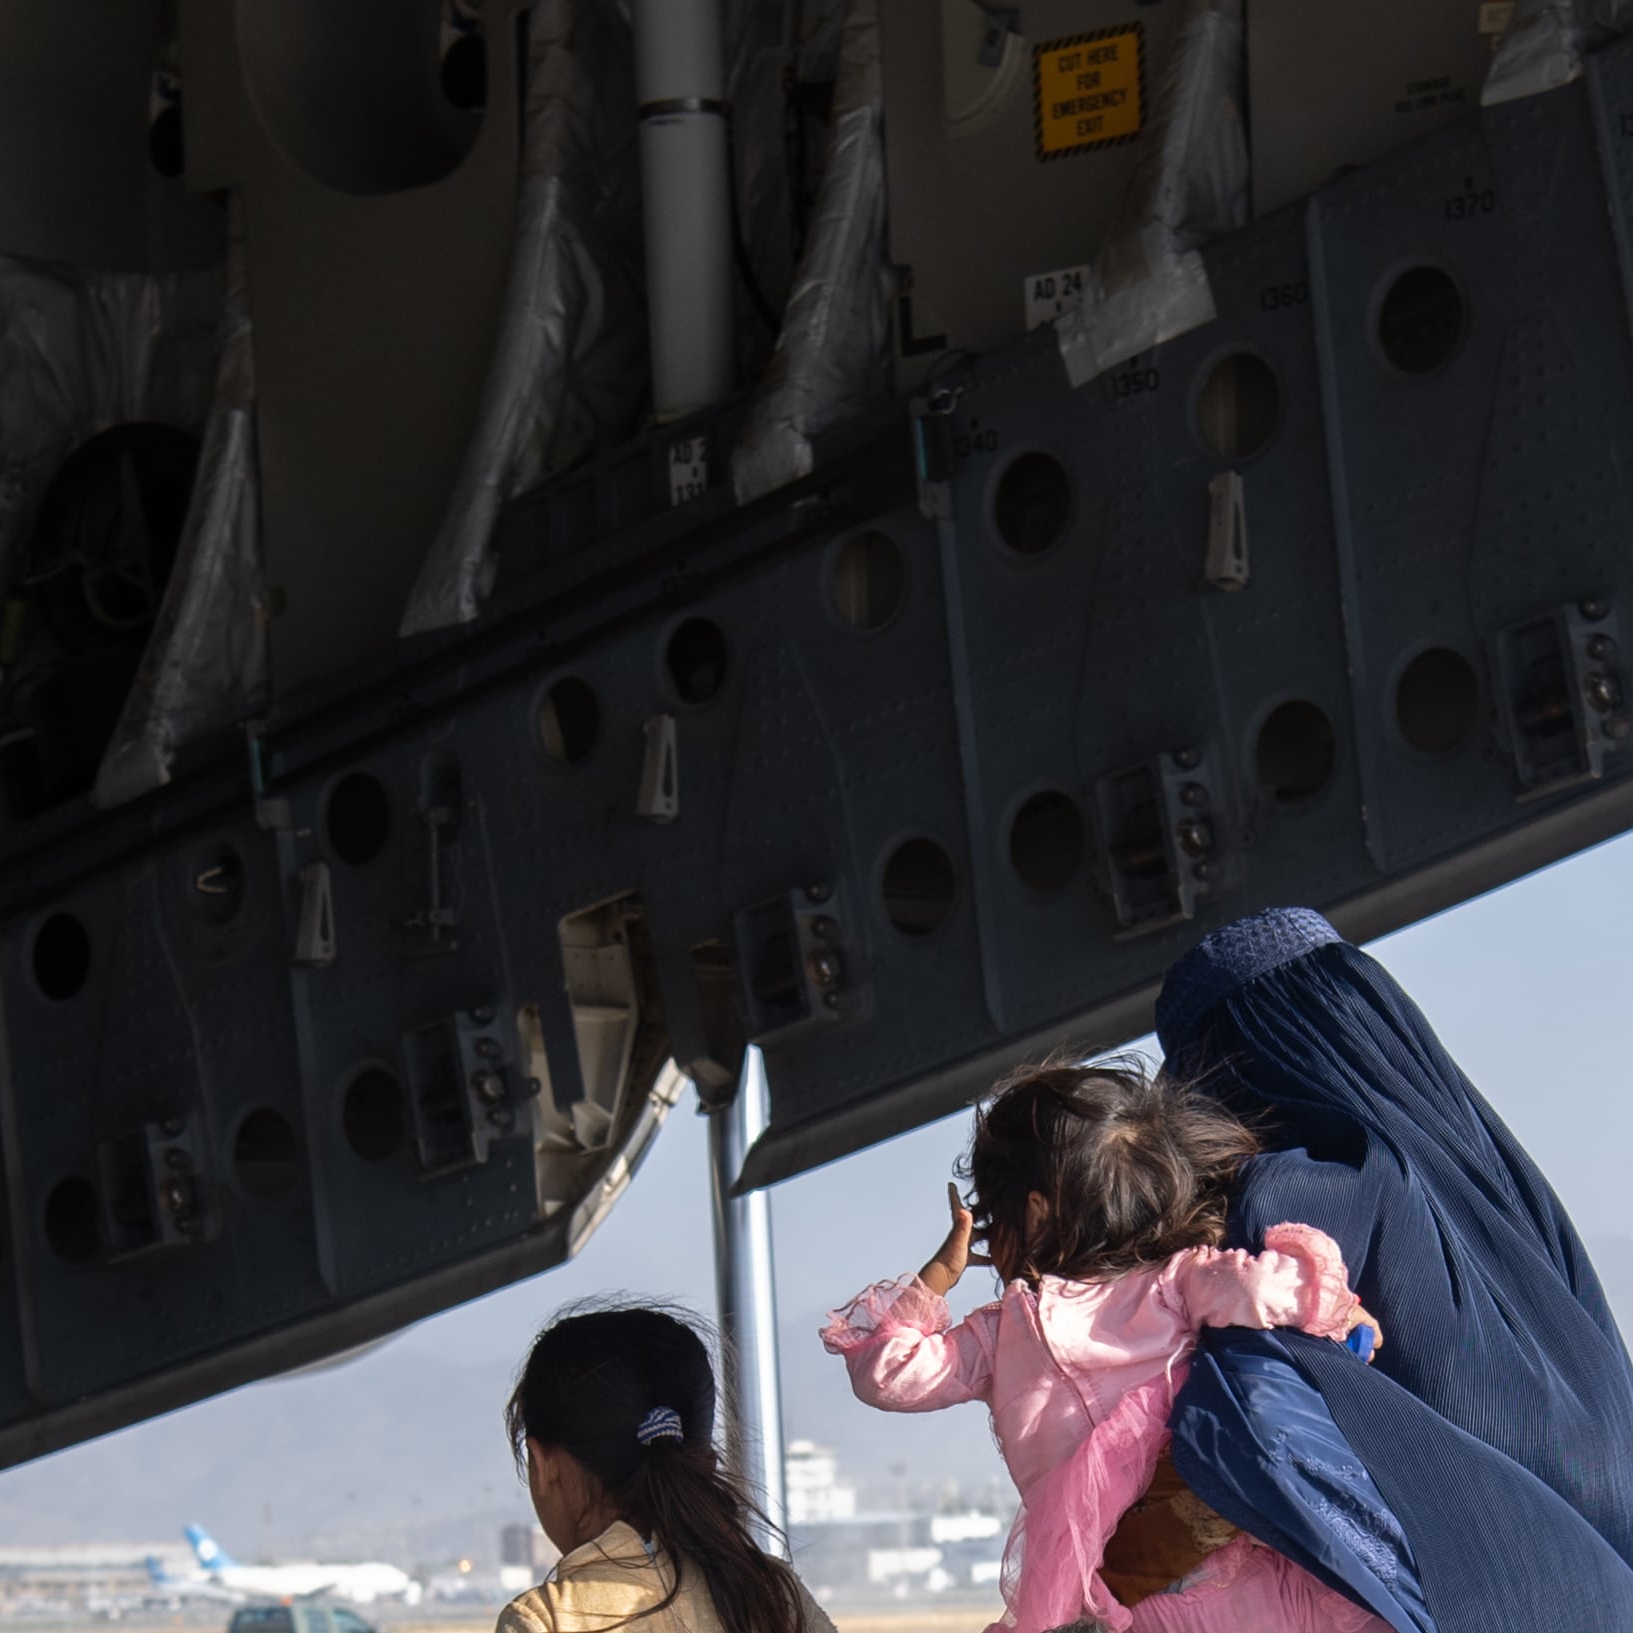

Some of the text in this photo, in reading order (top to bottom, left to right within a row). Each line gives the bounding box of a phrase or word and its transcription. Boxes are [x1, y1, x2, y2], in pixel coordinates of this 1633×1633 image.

[1058, 43, 1118, 74] CUT HERE
[1077, 70, 1101, 91] FOR
[1053, 87, 1128, 120] EMERGENCY
[1077, 115, 1104, 137] EXIT
[1444, 188, 1496, 222] 1370
[1033, 271, 1083, 301] AD 24
[1259, 280, 1309, 312] 1360
[1111, 367, 1160, 398] 1350
